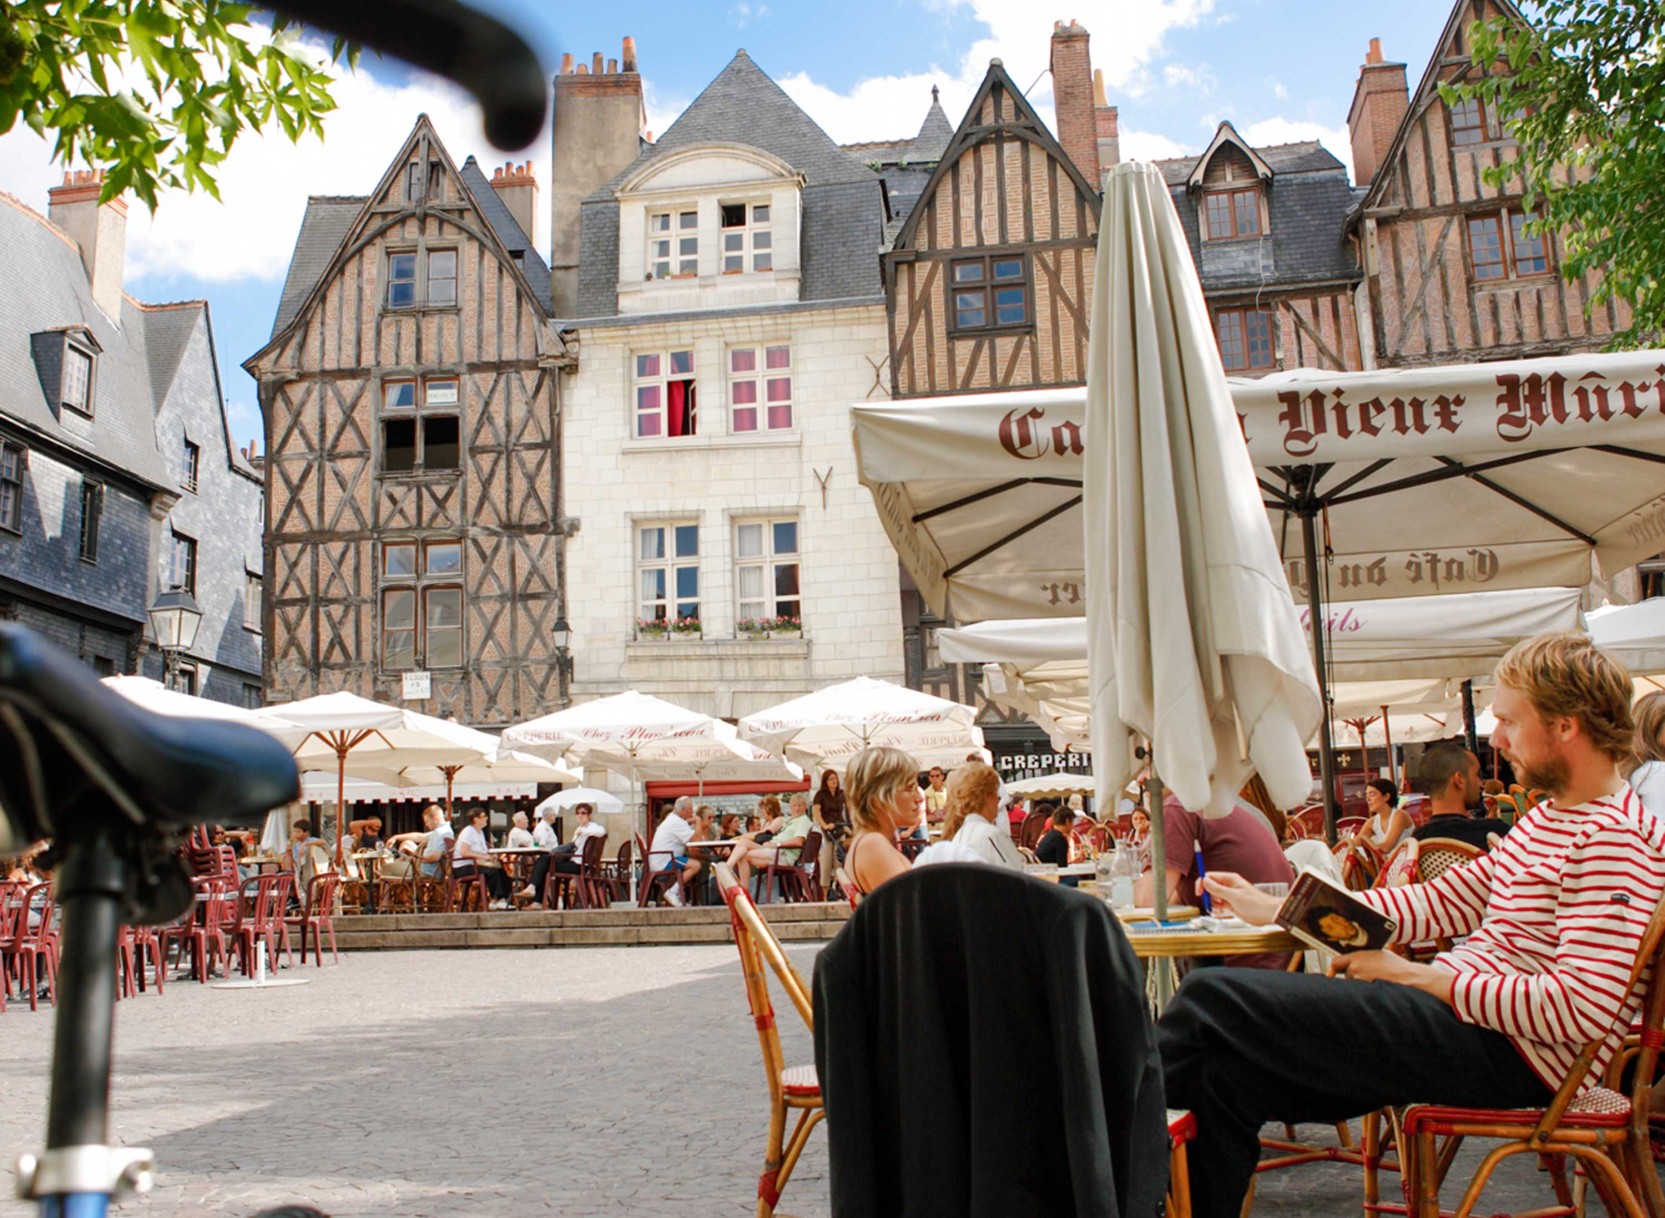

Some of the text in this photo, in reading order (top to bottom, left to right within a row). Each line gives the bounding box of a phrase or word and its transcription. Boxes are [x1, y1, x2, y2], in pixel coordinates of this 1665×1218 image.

[998, 406, 1085, 460] Ca
[1277, 386, 1467, 458] Vieux
[1495, 362, 1665, 443] Mûri
[1001, 752, 1089, 770] CREPERI
